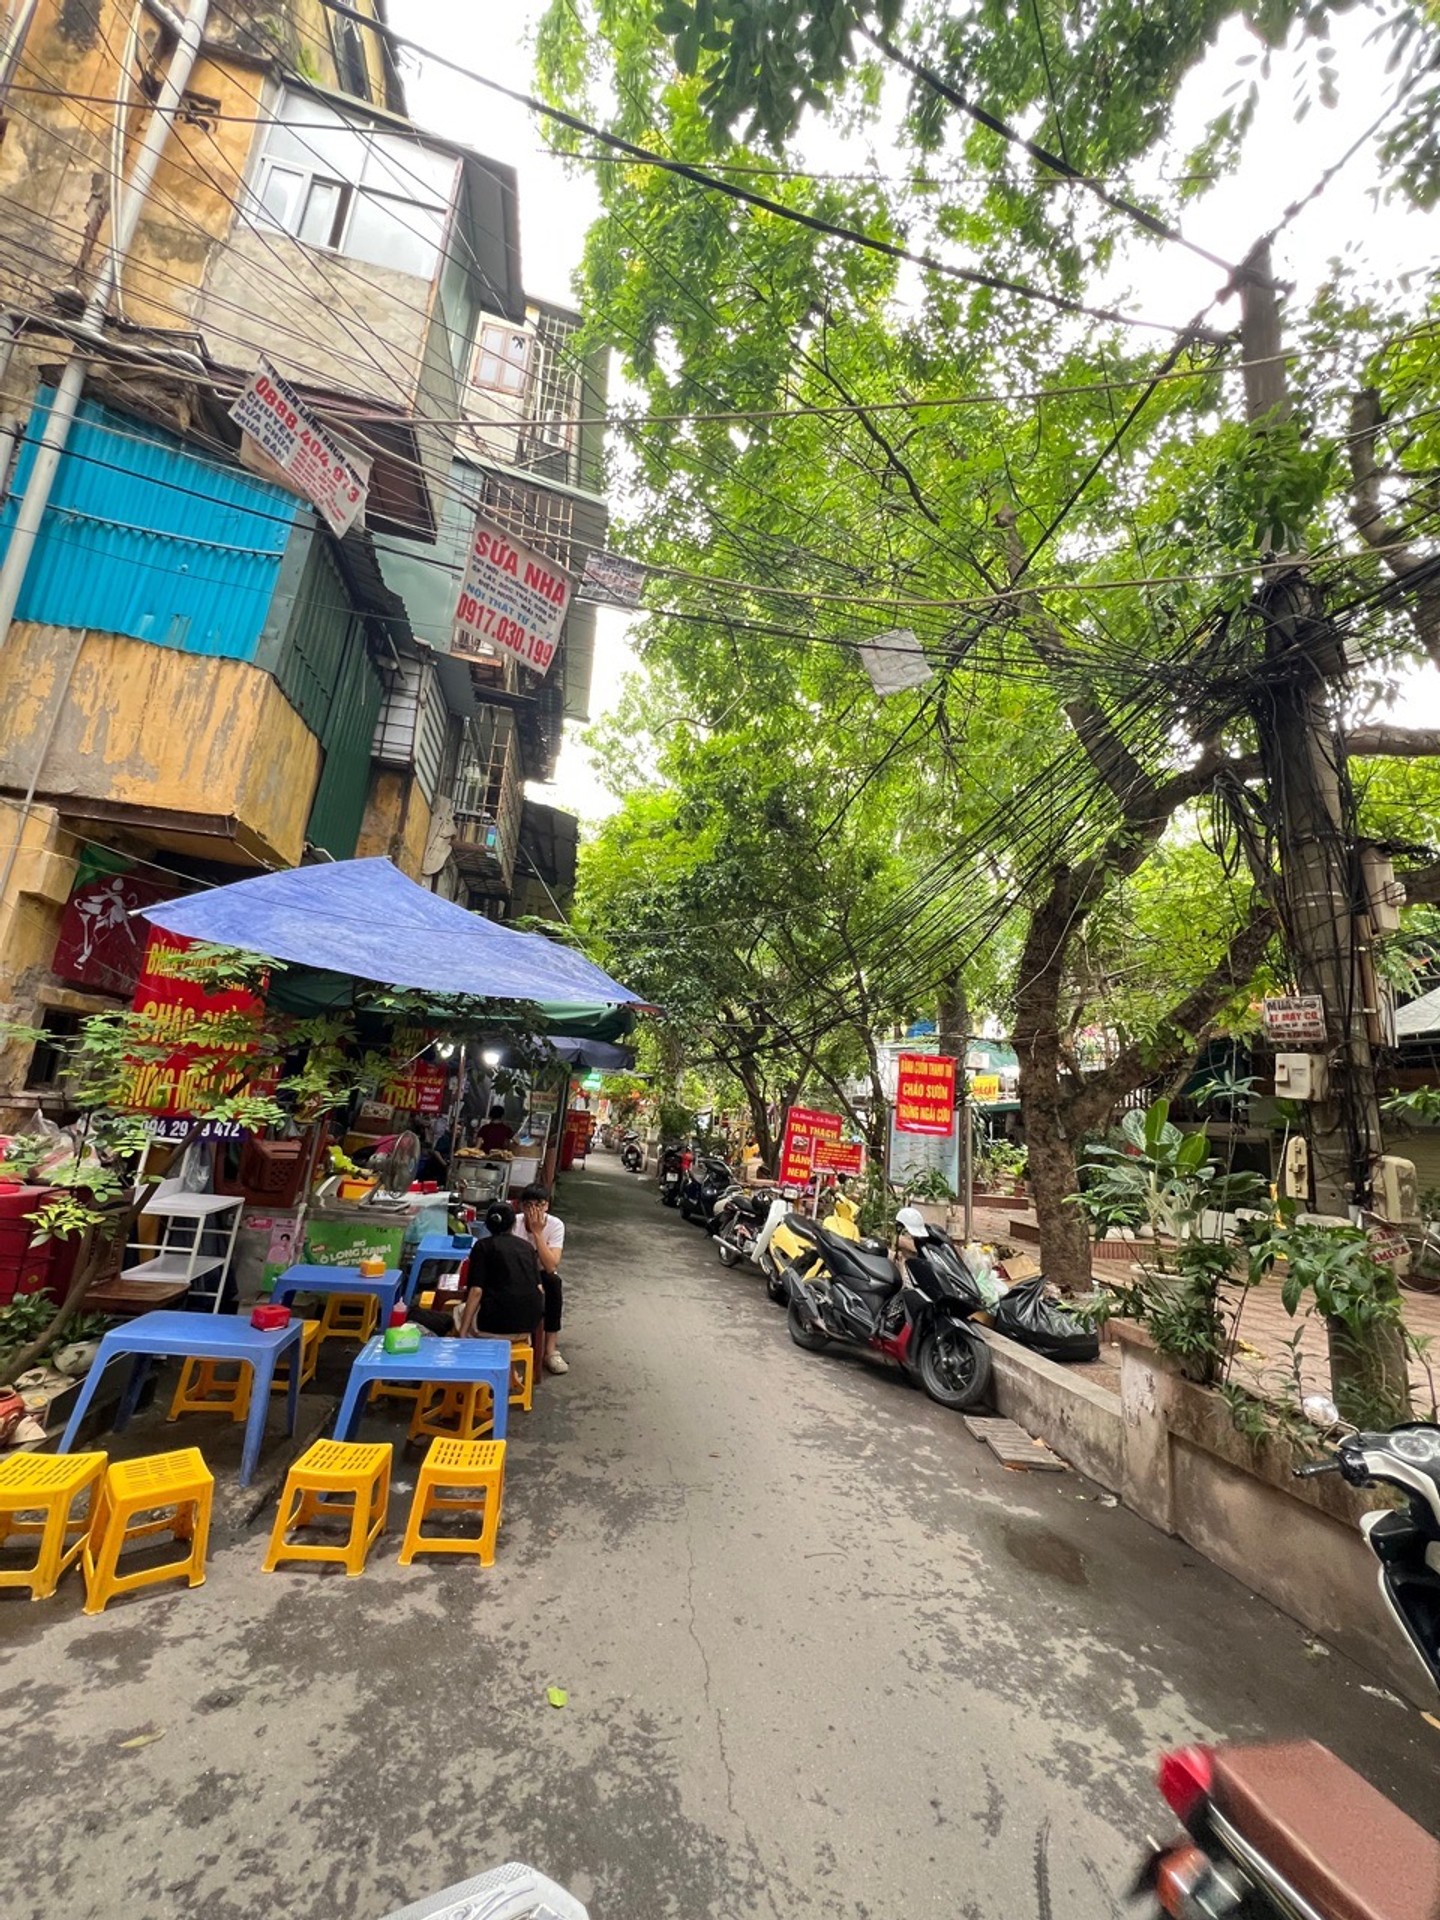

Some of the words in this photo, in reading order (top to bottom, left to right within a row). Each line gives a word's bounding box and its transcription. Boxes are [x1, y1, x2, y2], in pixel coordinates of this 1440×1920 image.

[234, 411, 261, 437] MUA
[475, 532, 518, 577] SỬA
[524, 561, 566, 608] NHÀ
[457, 593, 553, 668] 0917.030.199
[903, 1081, 924, 1097] CHÁO
[169, 1120, 188, 1137] 29
[213, 1121, 240, 1137] 472
[787, 1167, 808, 1178] NEM
[330, 1249, 360, 1261] LONG
